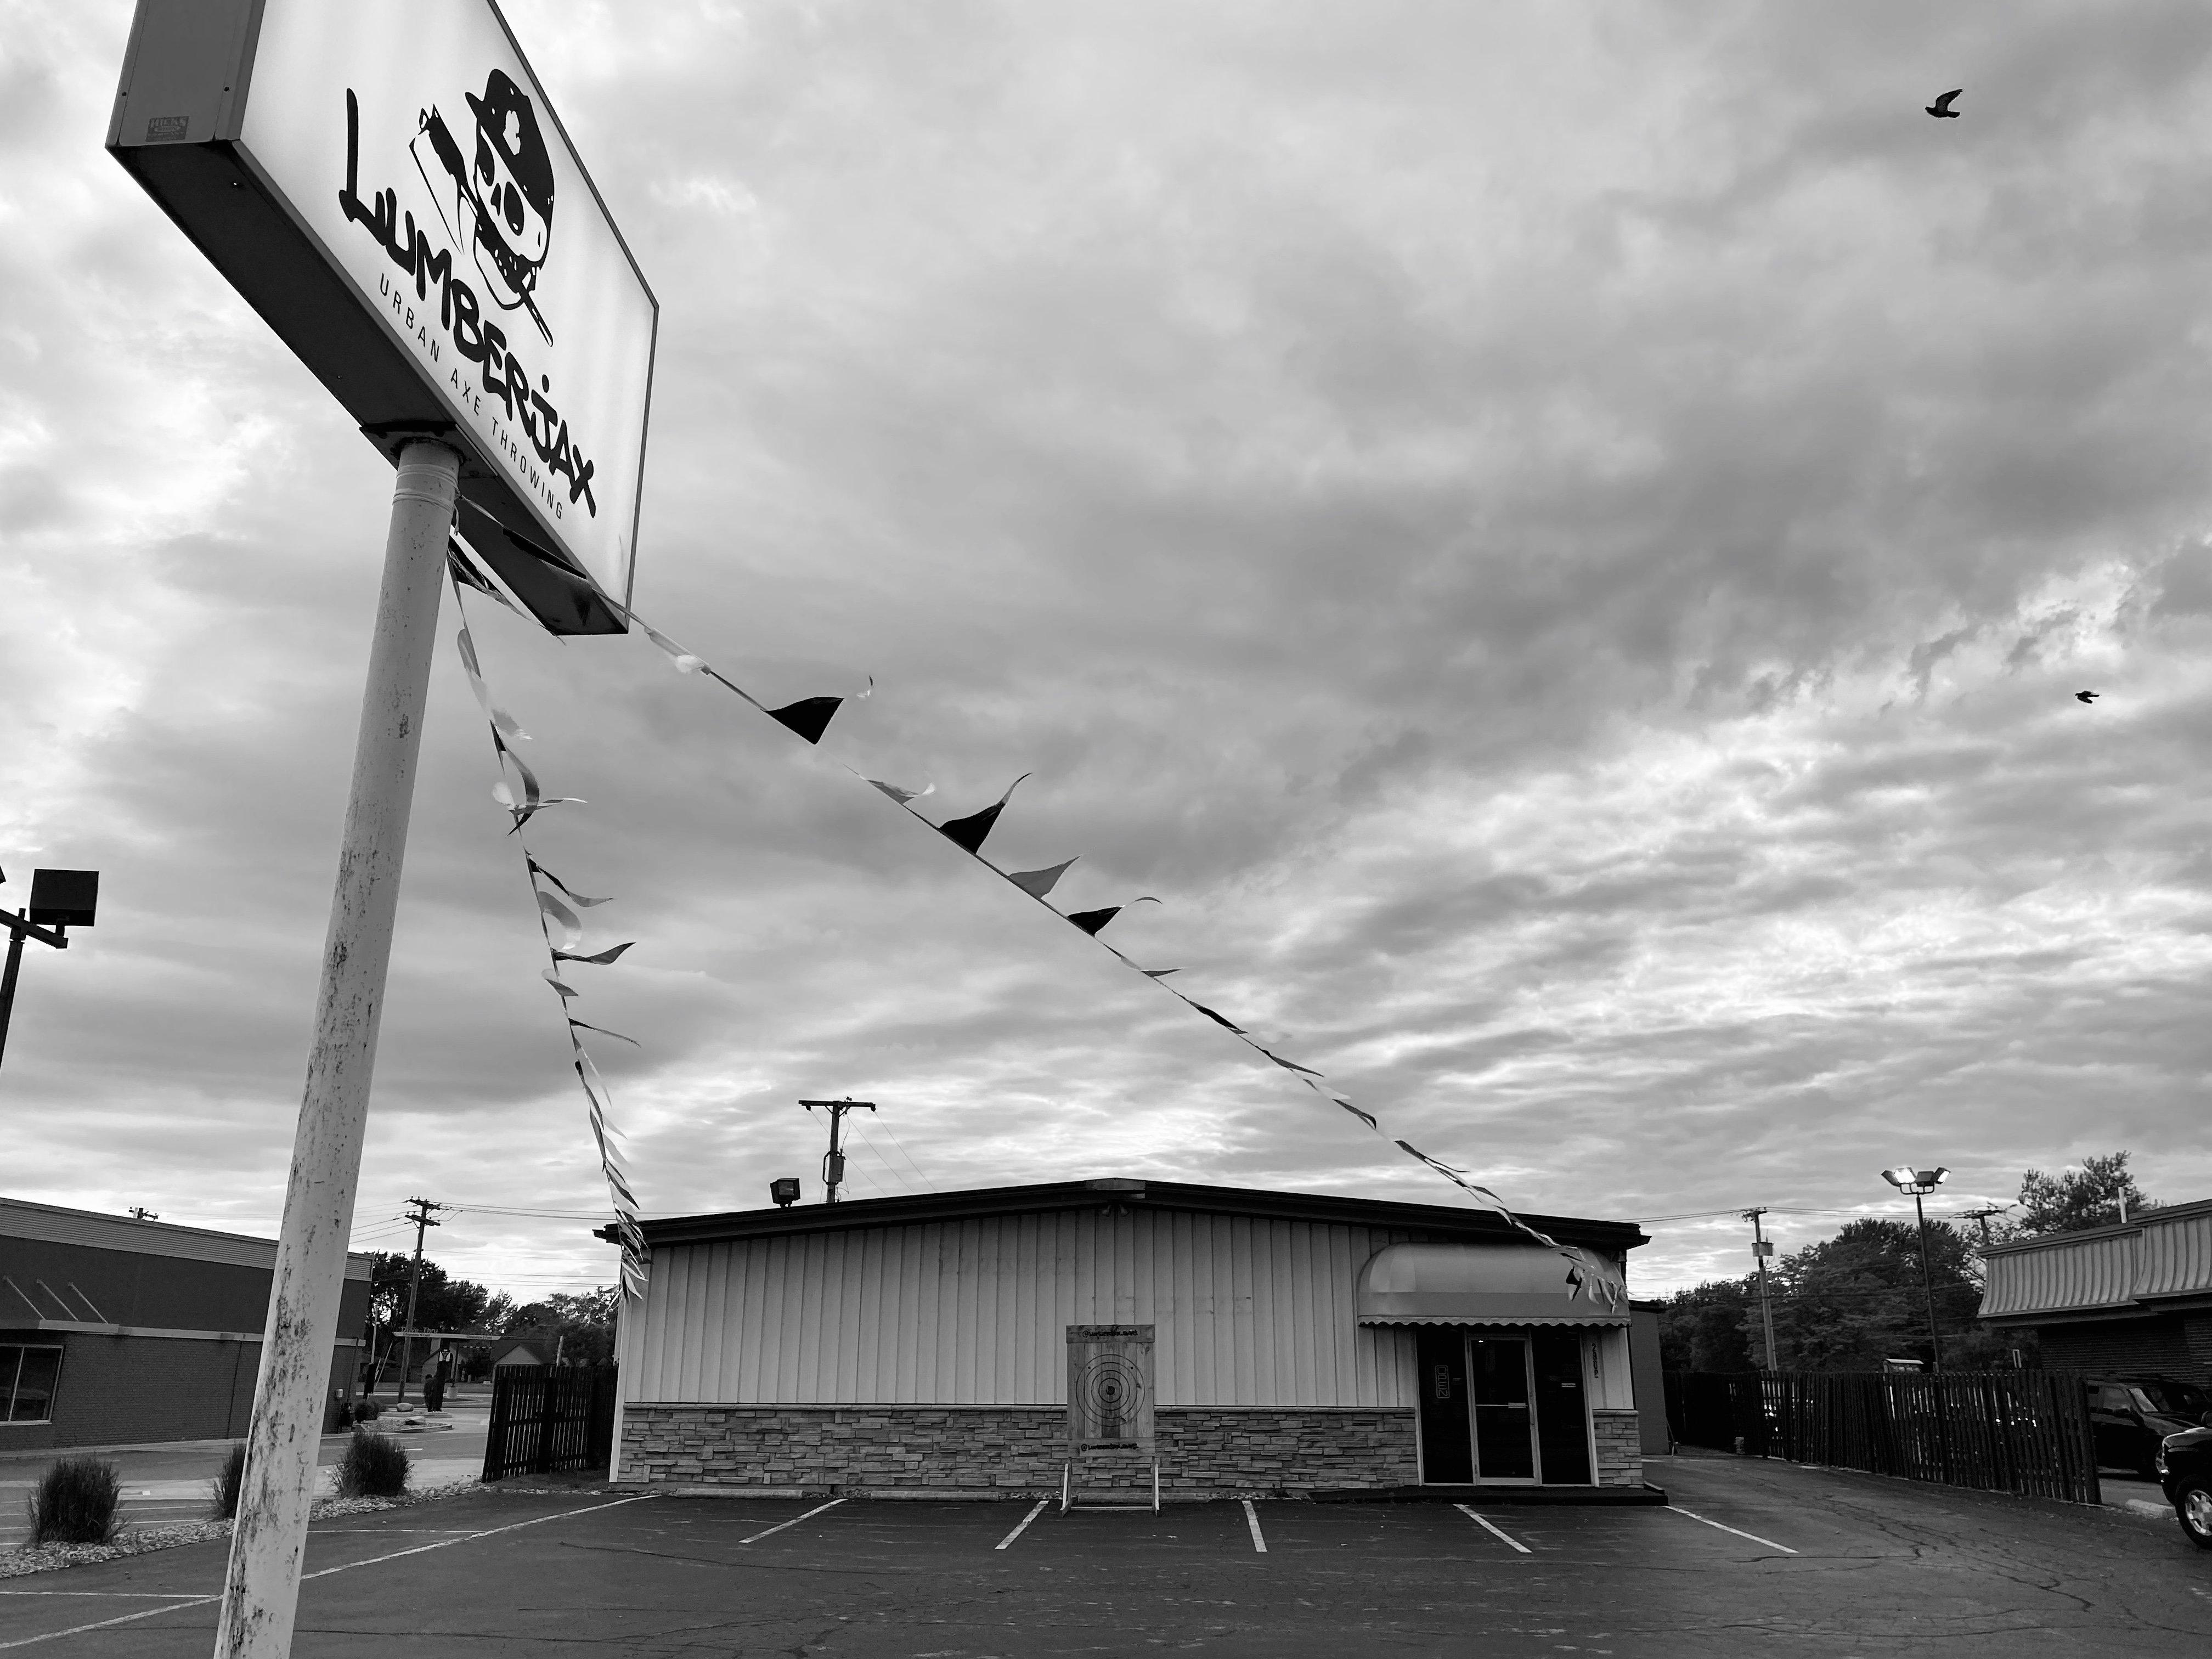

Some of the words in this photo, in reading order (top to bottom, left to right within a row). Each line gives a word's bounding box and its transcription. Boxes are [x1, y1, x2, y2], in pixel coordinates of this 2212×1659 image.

[380, 273, 440, 362] URBAN
[450, 368, 481, 416] AXE
[492, 416, 562, 520] THROWING
[1437, 1367, 1448, 1397] OPEN
